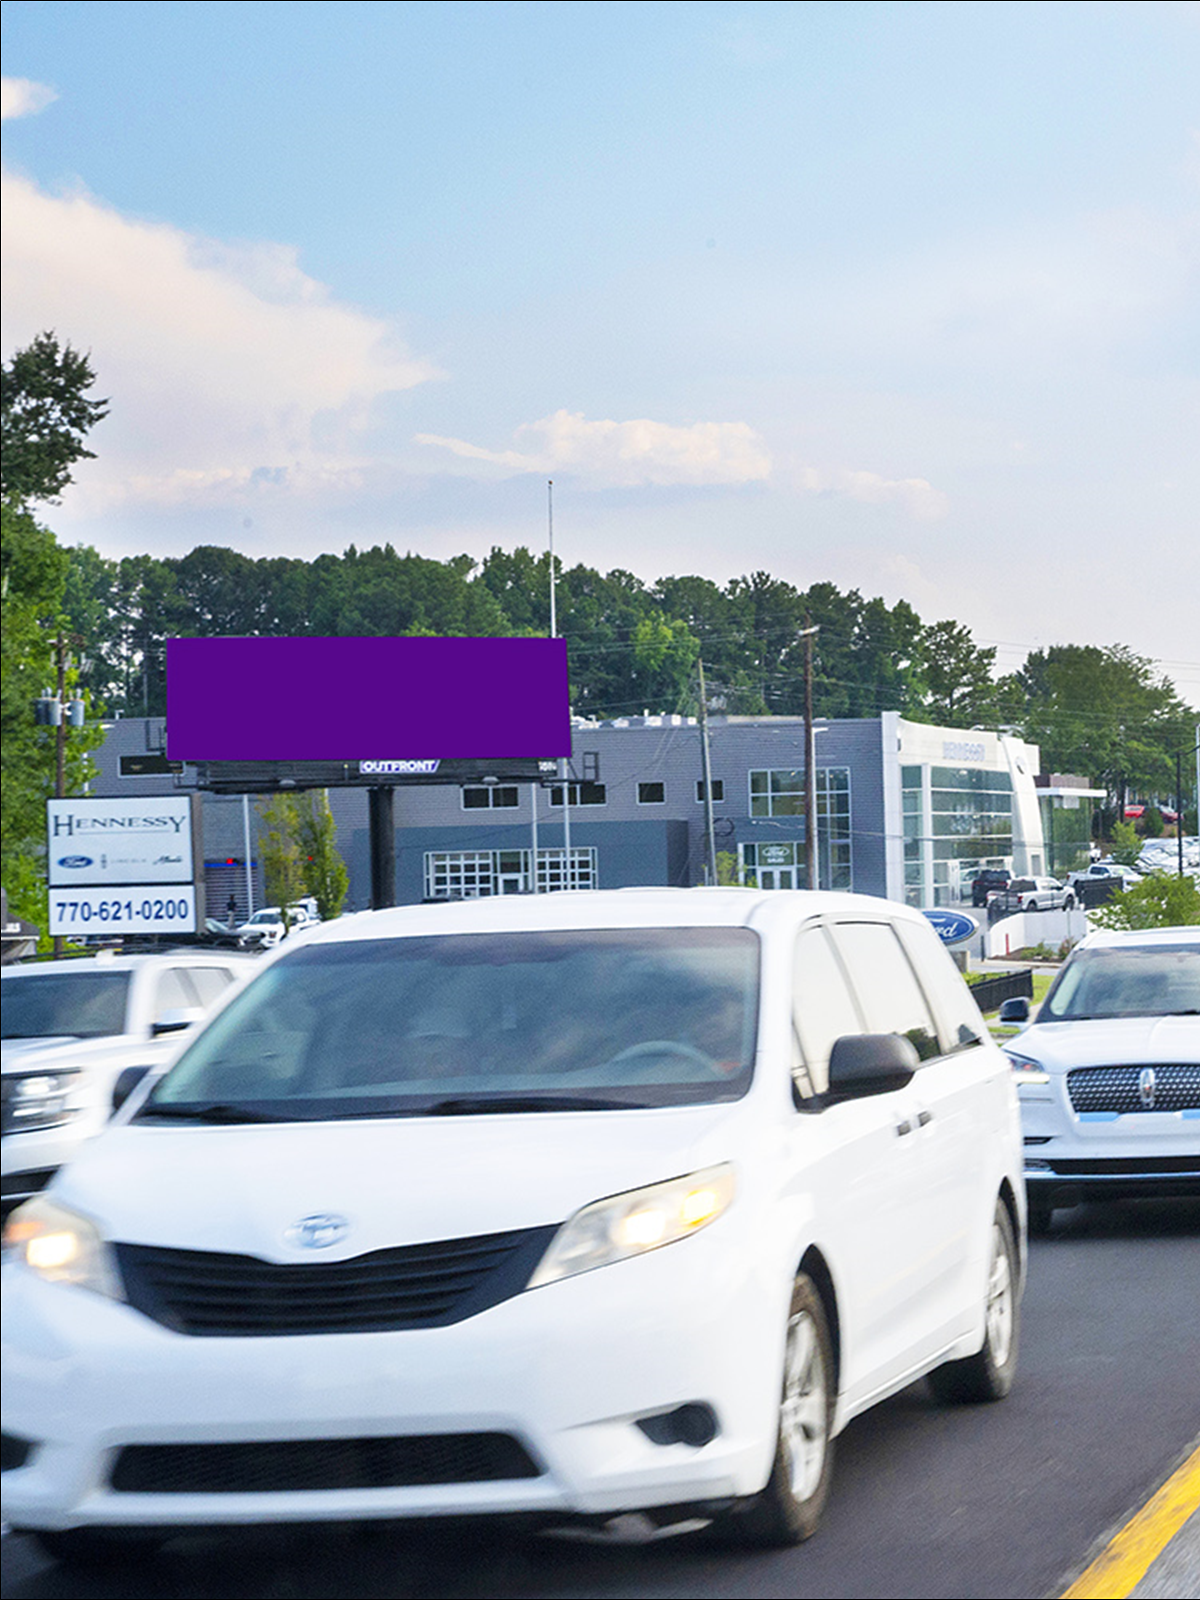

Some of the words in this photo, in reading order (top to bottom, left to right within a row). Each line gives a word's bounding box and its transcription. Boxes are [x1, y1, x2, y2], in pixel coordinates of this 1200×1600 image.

[363, 760, 437, 772] OUTFRONT
[53, 814, 186, 836] HENNESSY
[56, 899, 188, 922] 770-621-0200
